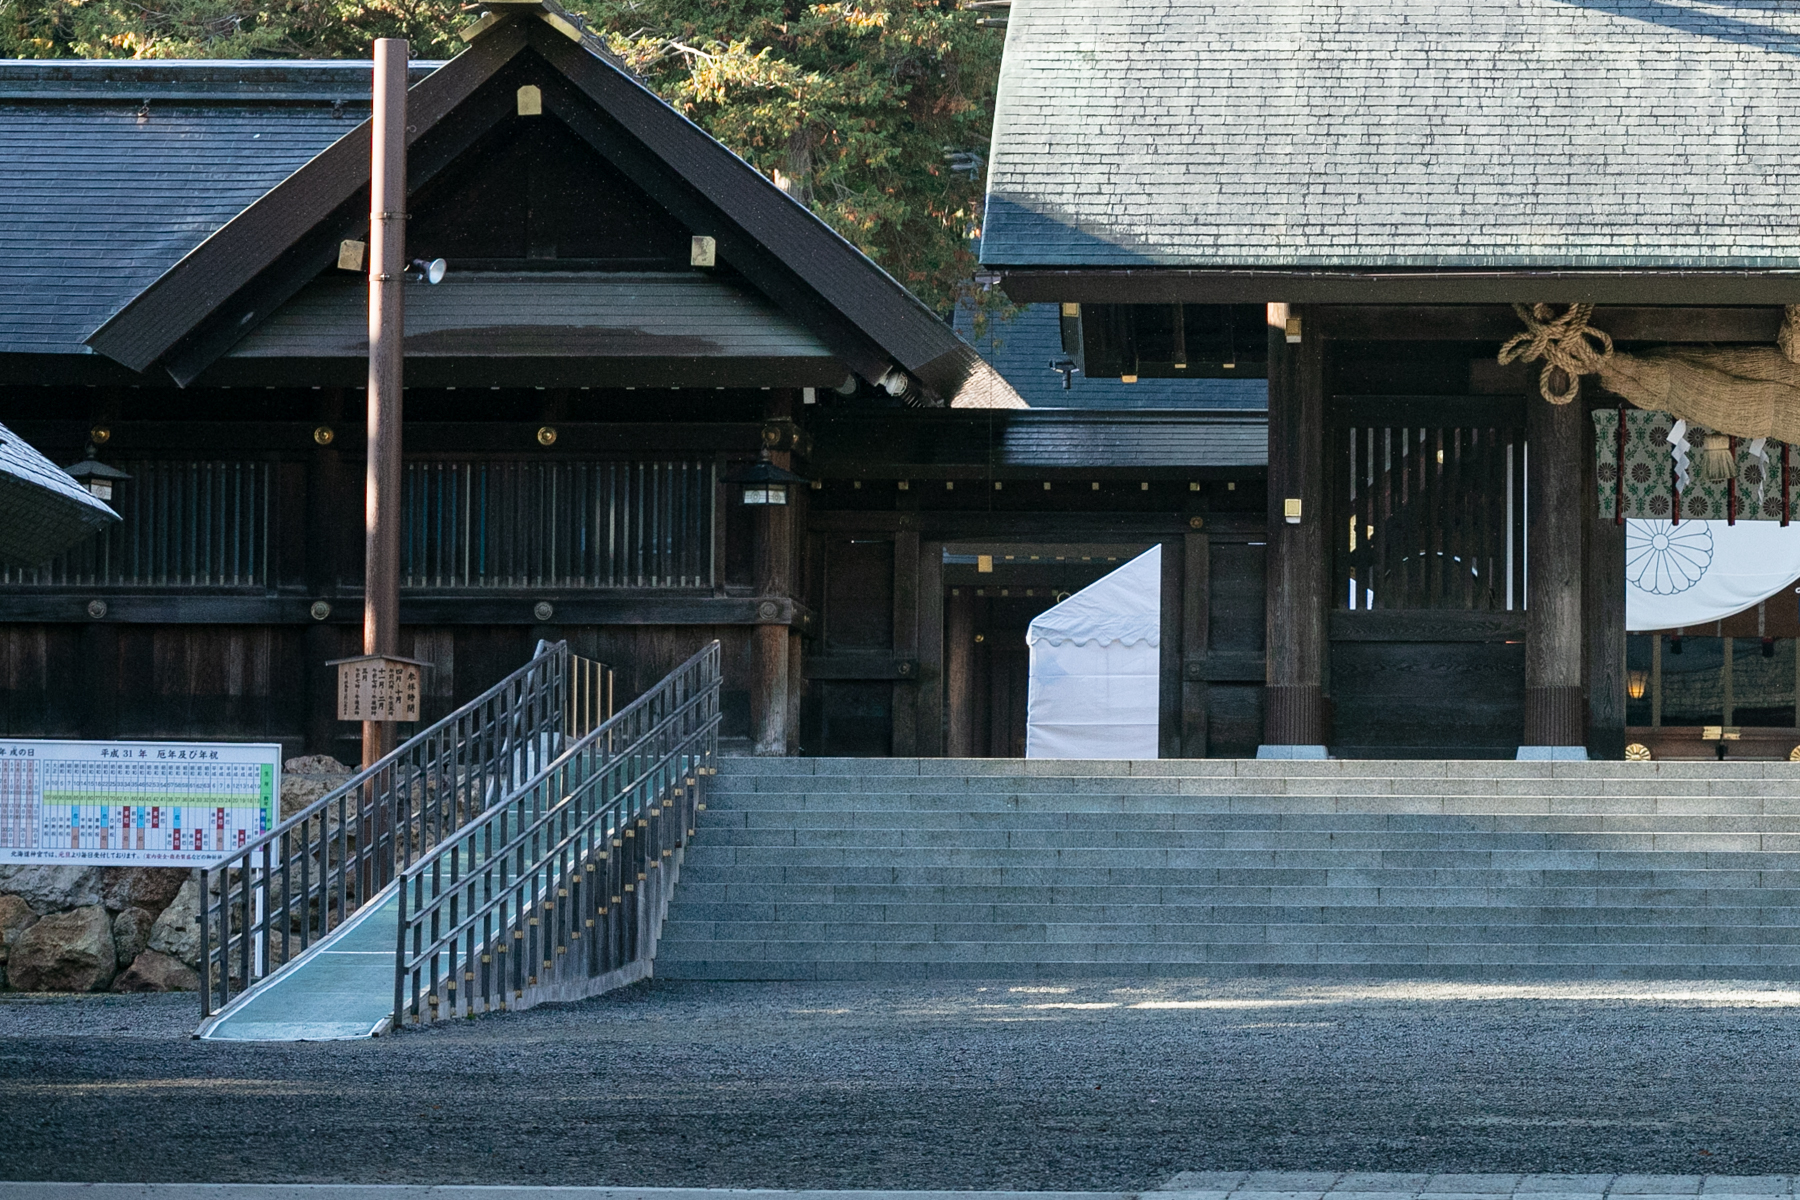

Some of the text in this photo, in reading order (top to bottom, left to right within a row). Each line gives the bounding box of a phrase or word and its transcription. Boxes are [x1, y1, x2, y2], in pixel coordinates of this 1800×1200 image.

[406, 672, 416, 714] 参拝時間
[100, 748, 219, 760] 平成 31 年 厄年及び年祝
